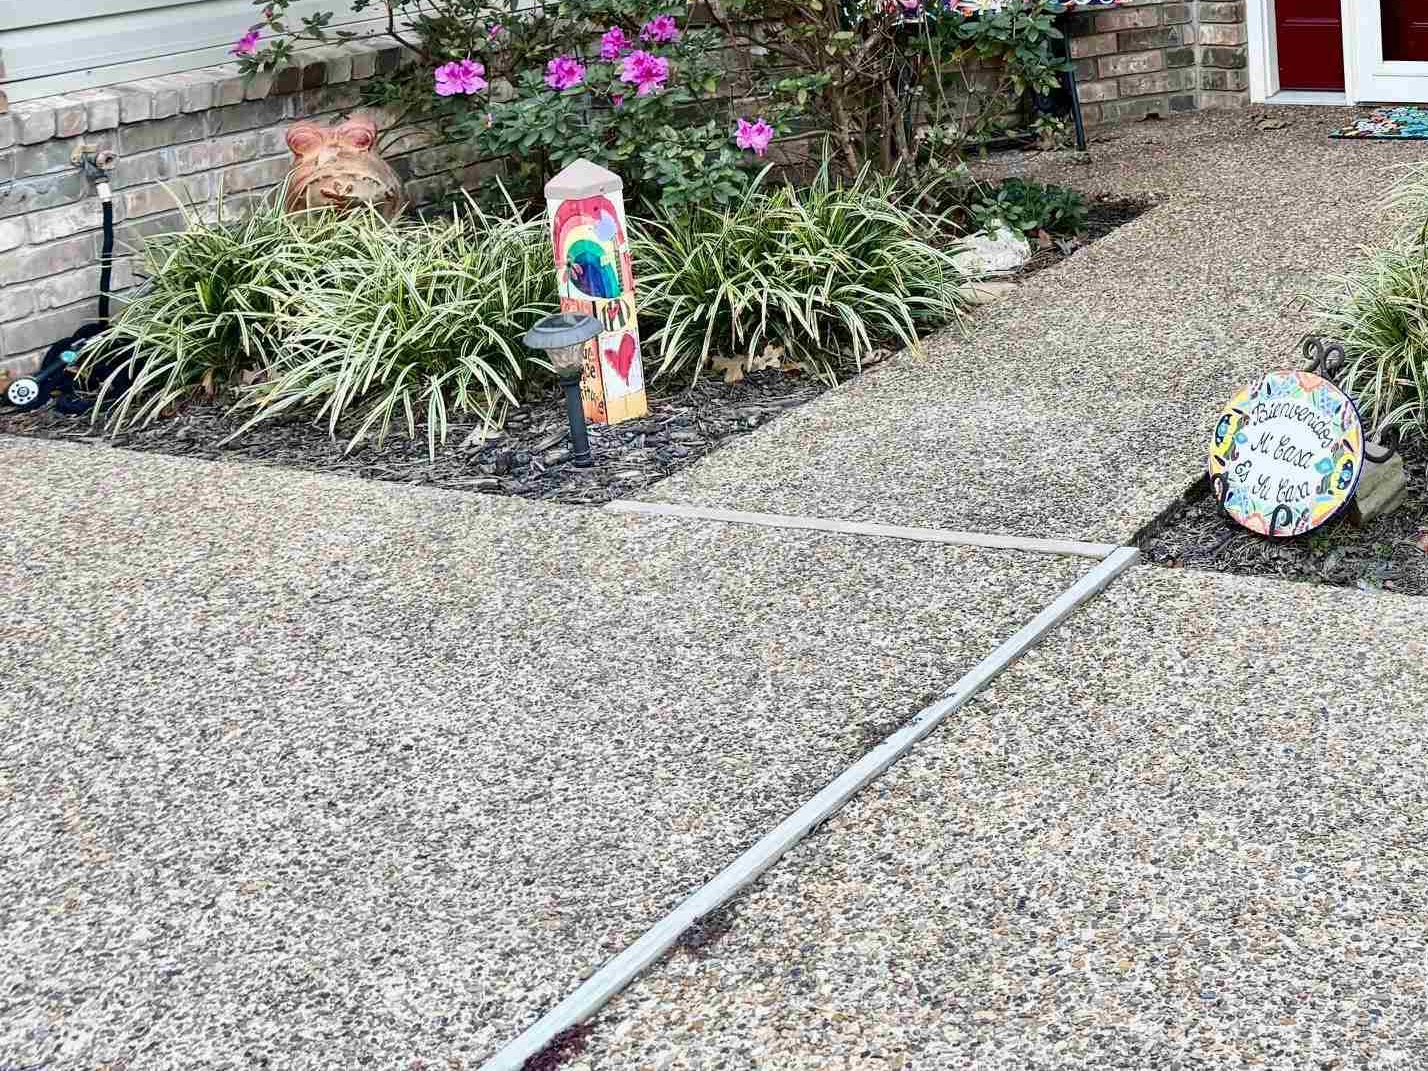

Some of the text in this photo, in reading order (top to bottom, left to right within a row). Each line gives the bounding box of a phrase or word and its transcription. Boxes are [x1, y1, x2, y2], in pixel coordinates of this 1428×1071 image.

[1251, 432, 1314, 469] Mi Casa
[1235, 460, 1252, 483] Es
[1252, 474, 1310, 503] Su Casa
